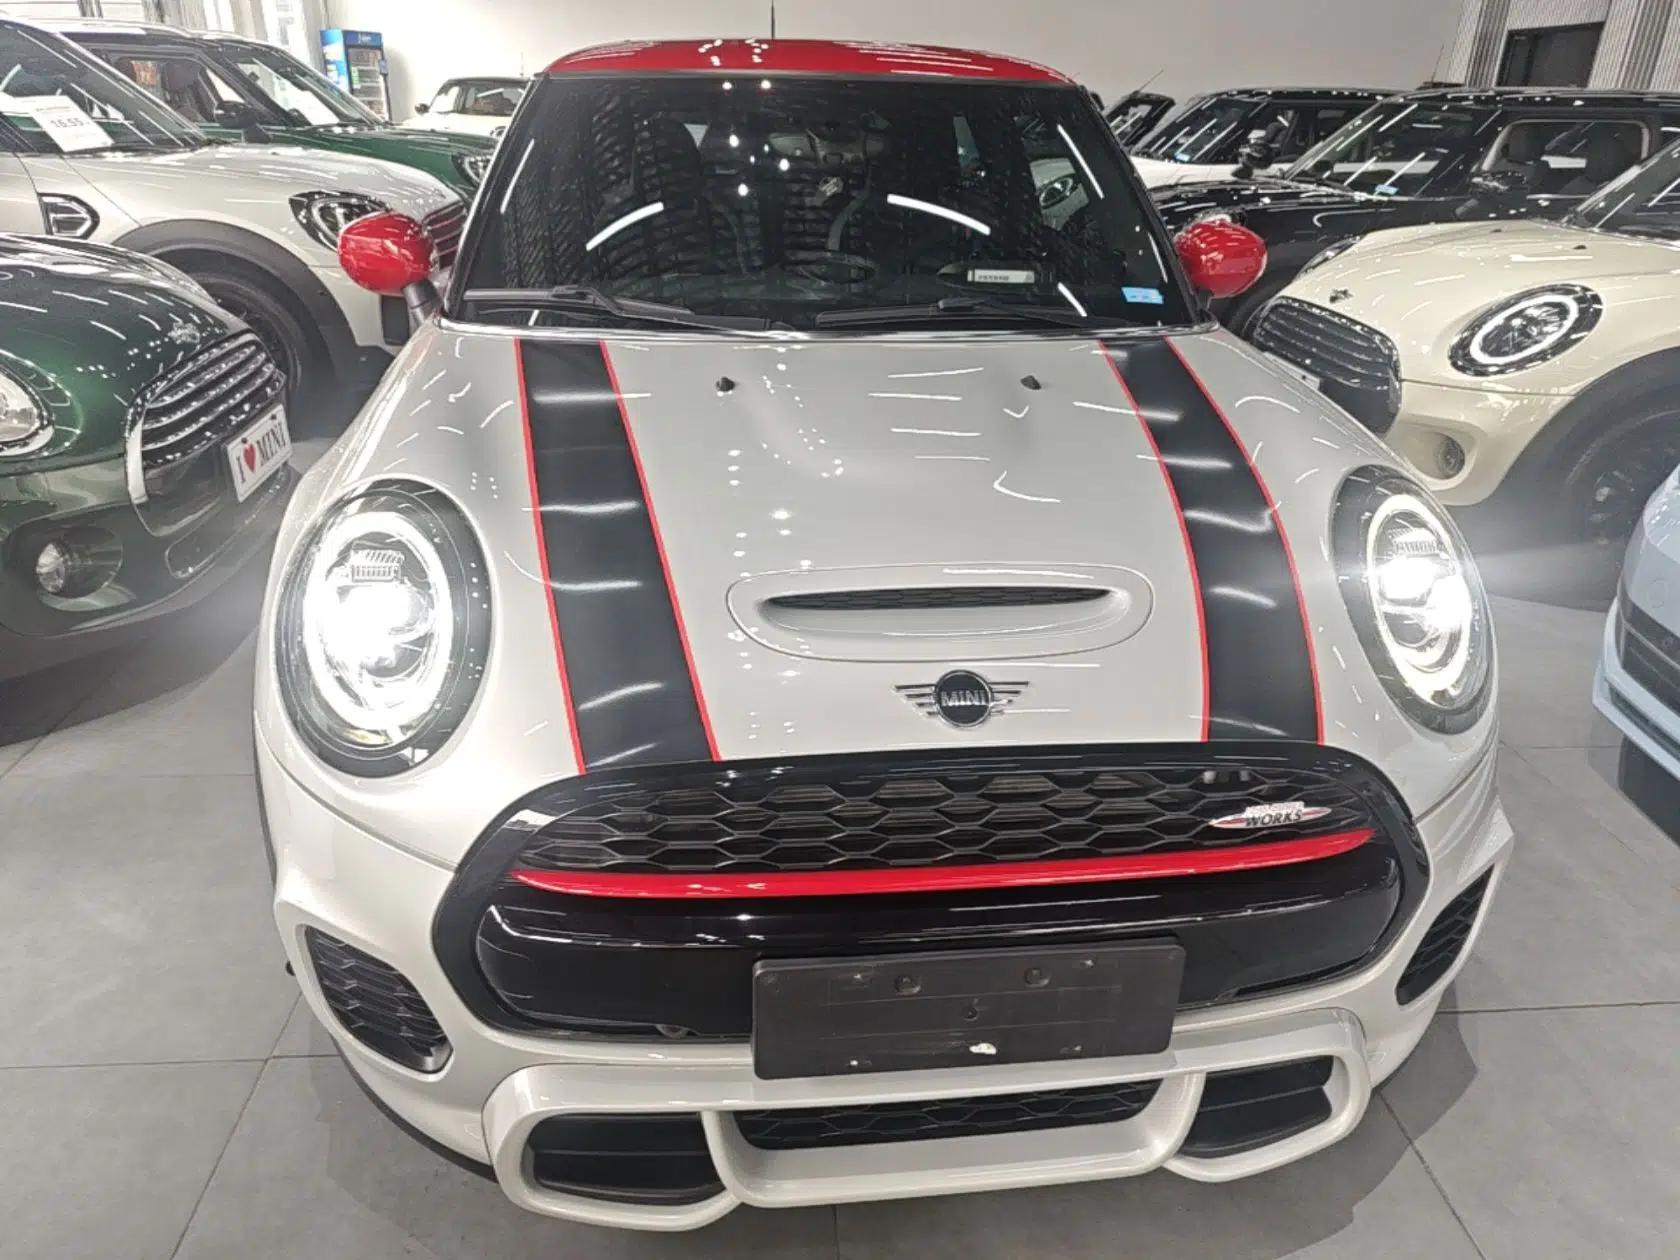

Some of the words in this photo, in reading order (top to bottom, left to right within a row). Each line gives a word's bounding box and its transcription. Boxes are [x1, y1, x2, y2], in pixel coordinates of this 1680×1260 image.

[236, 455, 246, 483] I
[256, 420, 286, 467] MINI
[941, 690, 987, 706] MINI
[1246, 809, 1303, 827] WORKS
